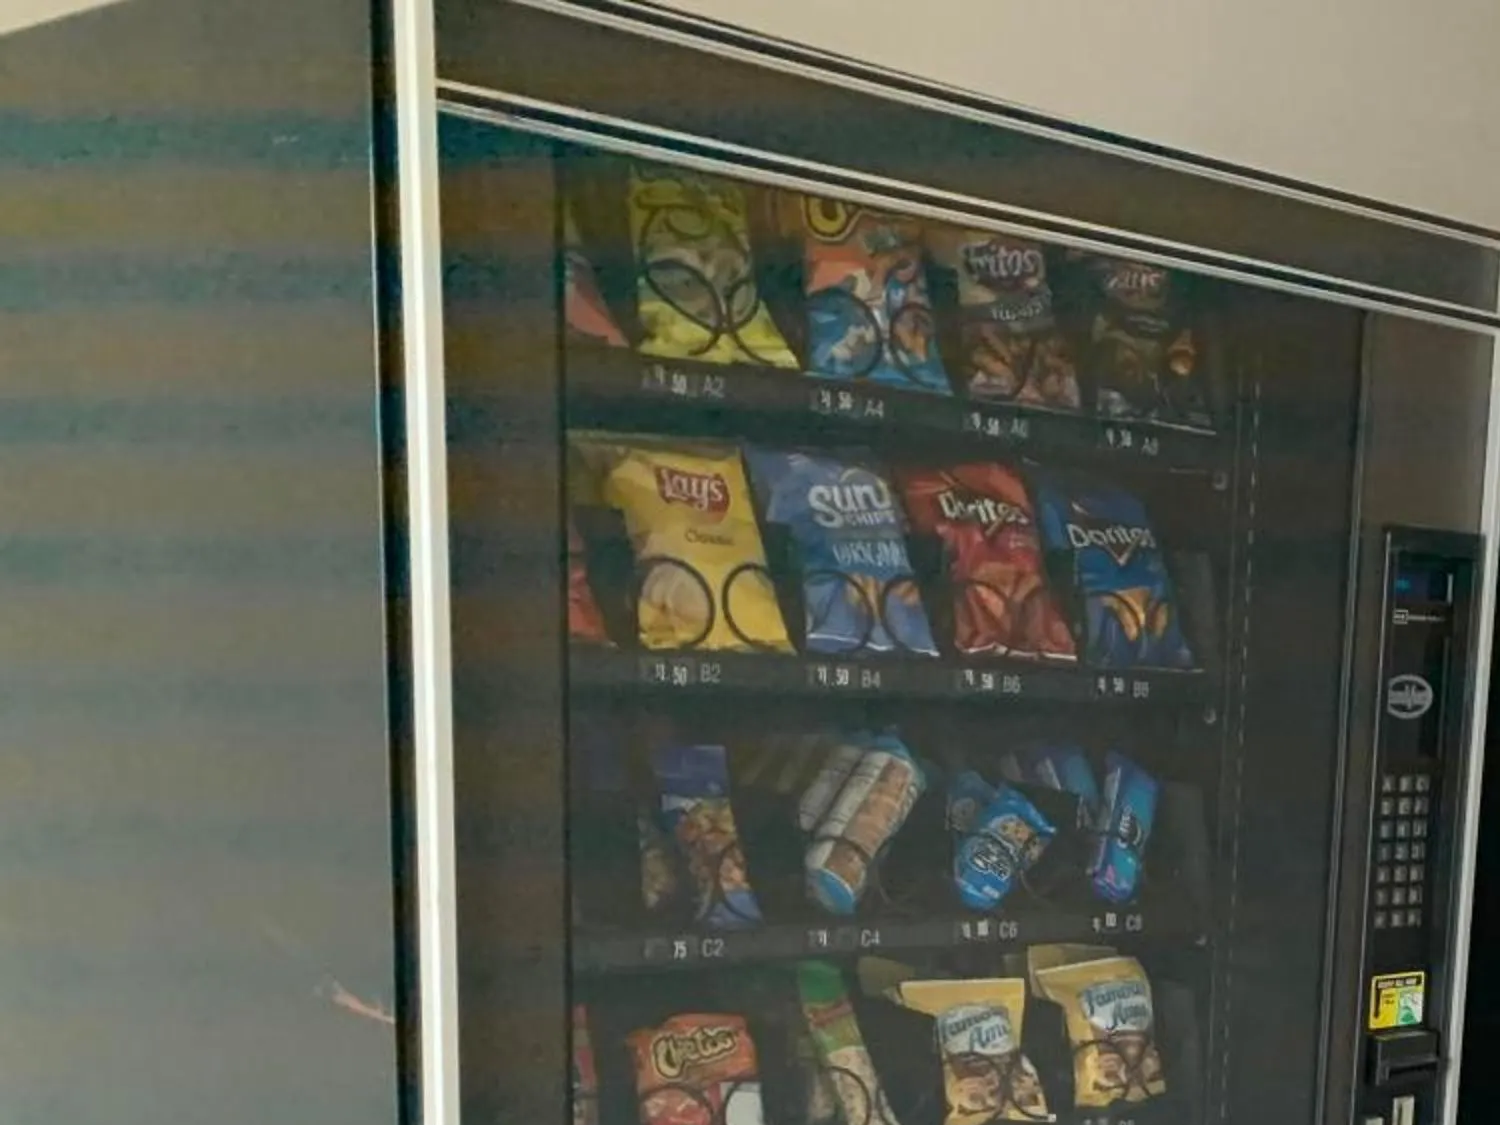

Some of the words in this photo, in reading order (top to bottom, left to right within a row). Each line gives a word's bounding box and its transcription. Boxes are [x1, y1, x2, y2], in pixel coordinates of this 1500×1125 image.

[938, 490, 1030, 524] Doritos
[1066, 523, 1156, 549] Doritos
[700, 663, 721, 684] B2
[702, 938, 725, 958] C2
[861, 929, 881, 947] C4
